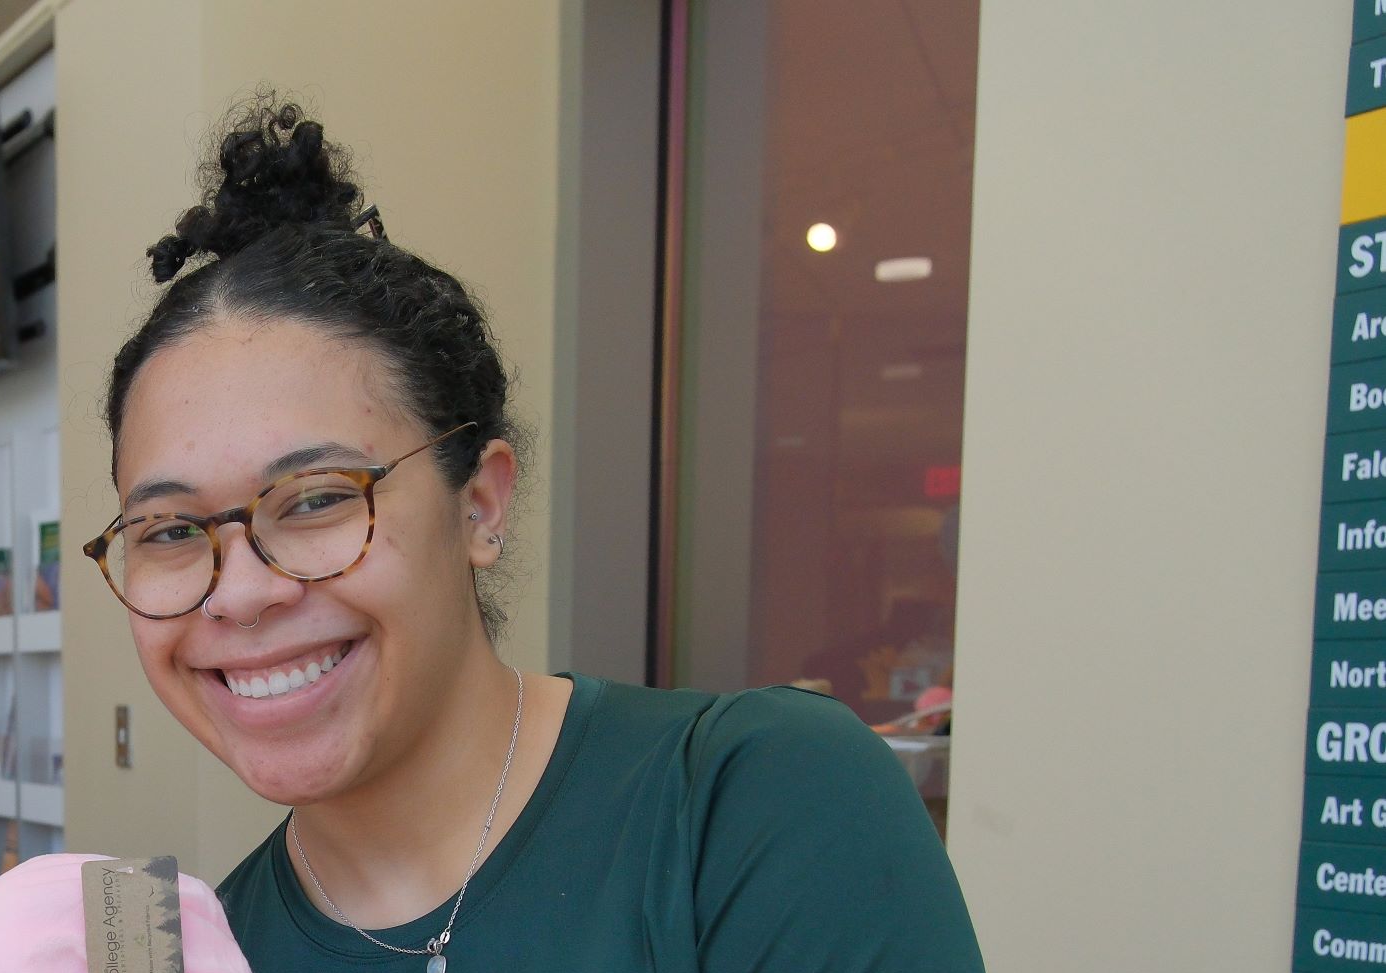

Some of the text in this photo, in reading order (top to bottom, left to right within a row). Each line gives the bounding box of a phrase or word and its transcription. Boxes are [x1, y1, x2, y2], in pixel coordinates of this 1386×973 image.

[1349, 382, 1386, 412] Bo
[1337, 519, 1386, 551] Info
[1333, 592, 1386, 622] Mee
[1329, 660, 1386, 688] Nort
[1320, 796, 1364, 826] Art
[1316, 862, 1386, 897] Cente
[102, 868, 118, 927] Agency
[1313, 928, 1386, 964] Comm
